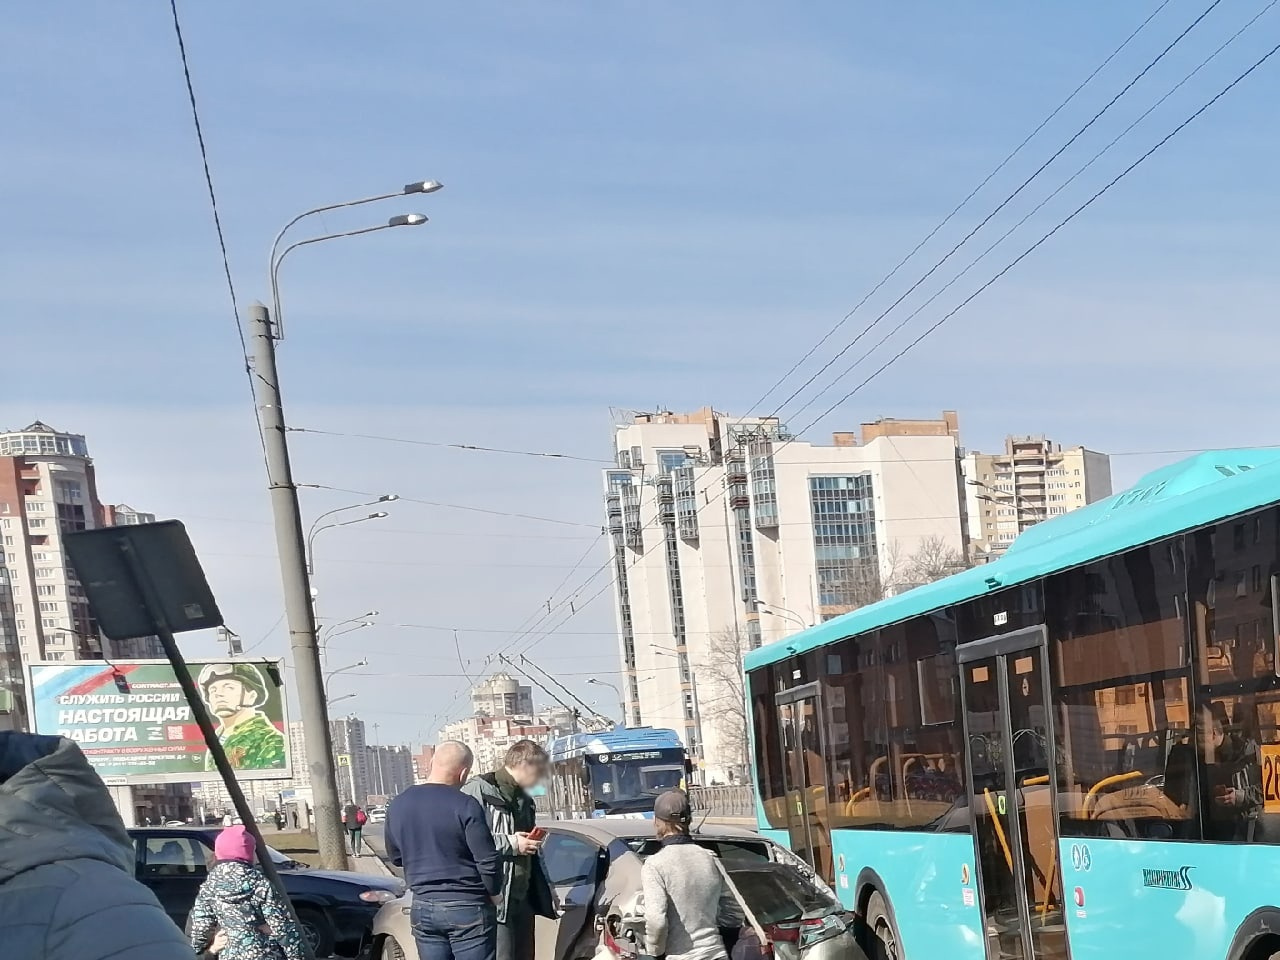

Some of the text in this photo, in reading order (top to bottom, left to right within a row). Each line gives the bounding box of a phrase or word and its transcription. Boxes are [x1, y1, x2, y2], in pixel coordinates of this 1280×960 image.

[60, 693, 180, 705] СЛУЖИТЬ РОССИИ
[59, 706, 190, 724] НАСТОЯЩАЯ
